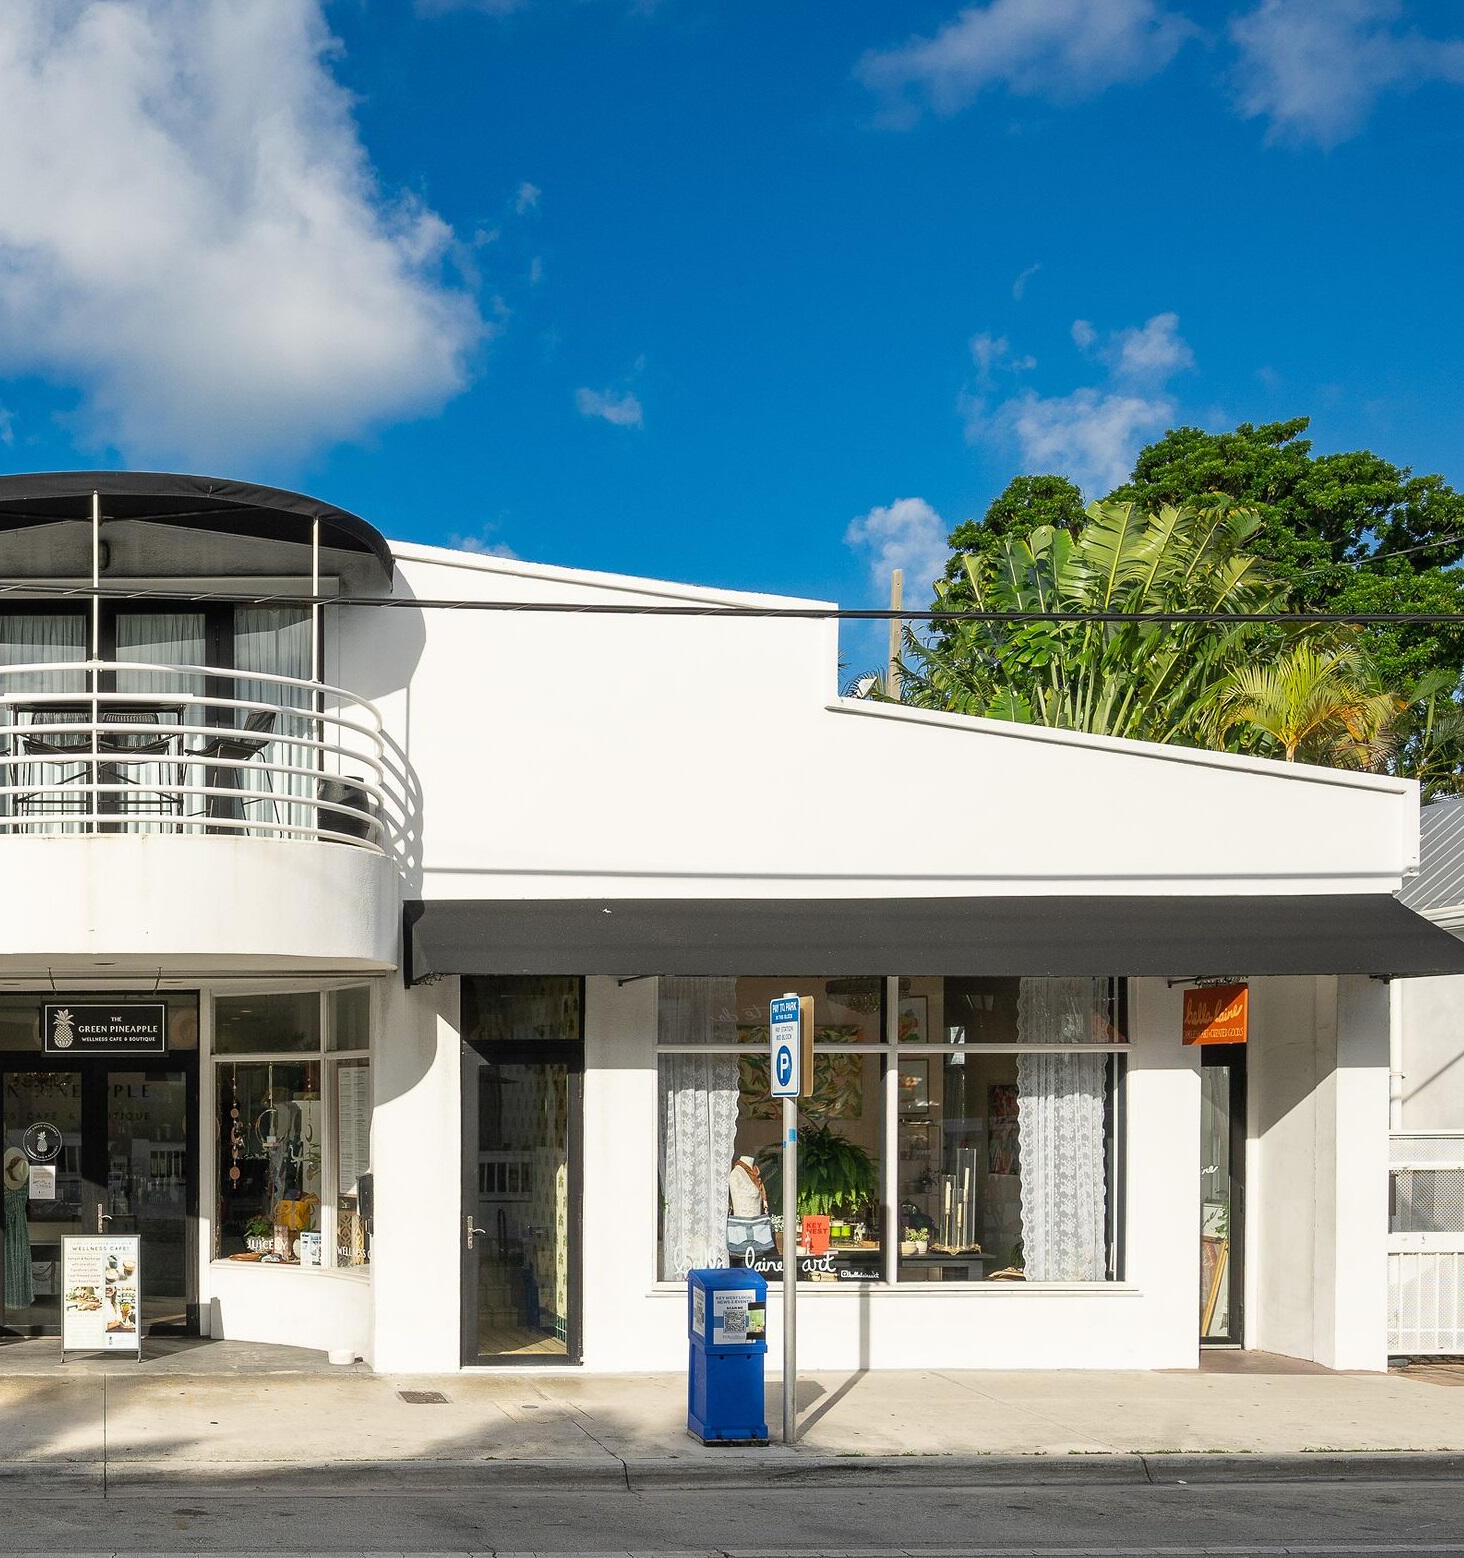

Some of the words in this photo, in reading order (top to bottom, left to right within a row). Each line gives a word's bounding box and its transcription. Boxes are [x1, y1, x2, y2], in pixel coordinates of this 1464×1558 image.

[78, 1025, 107, 1033] GREEN
[110, 1025, 158, 1033] PINEAPPLE
[780, 1052, 789, 1080] P
[744, 1246, 785, 1273] laine
[801, 1253, 837, 1273] art
